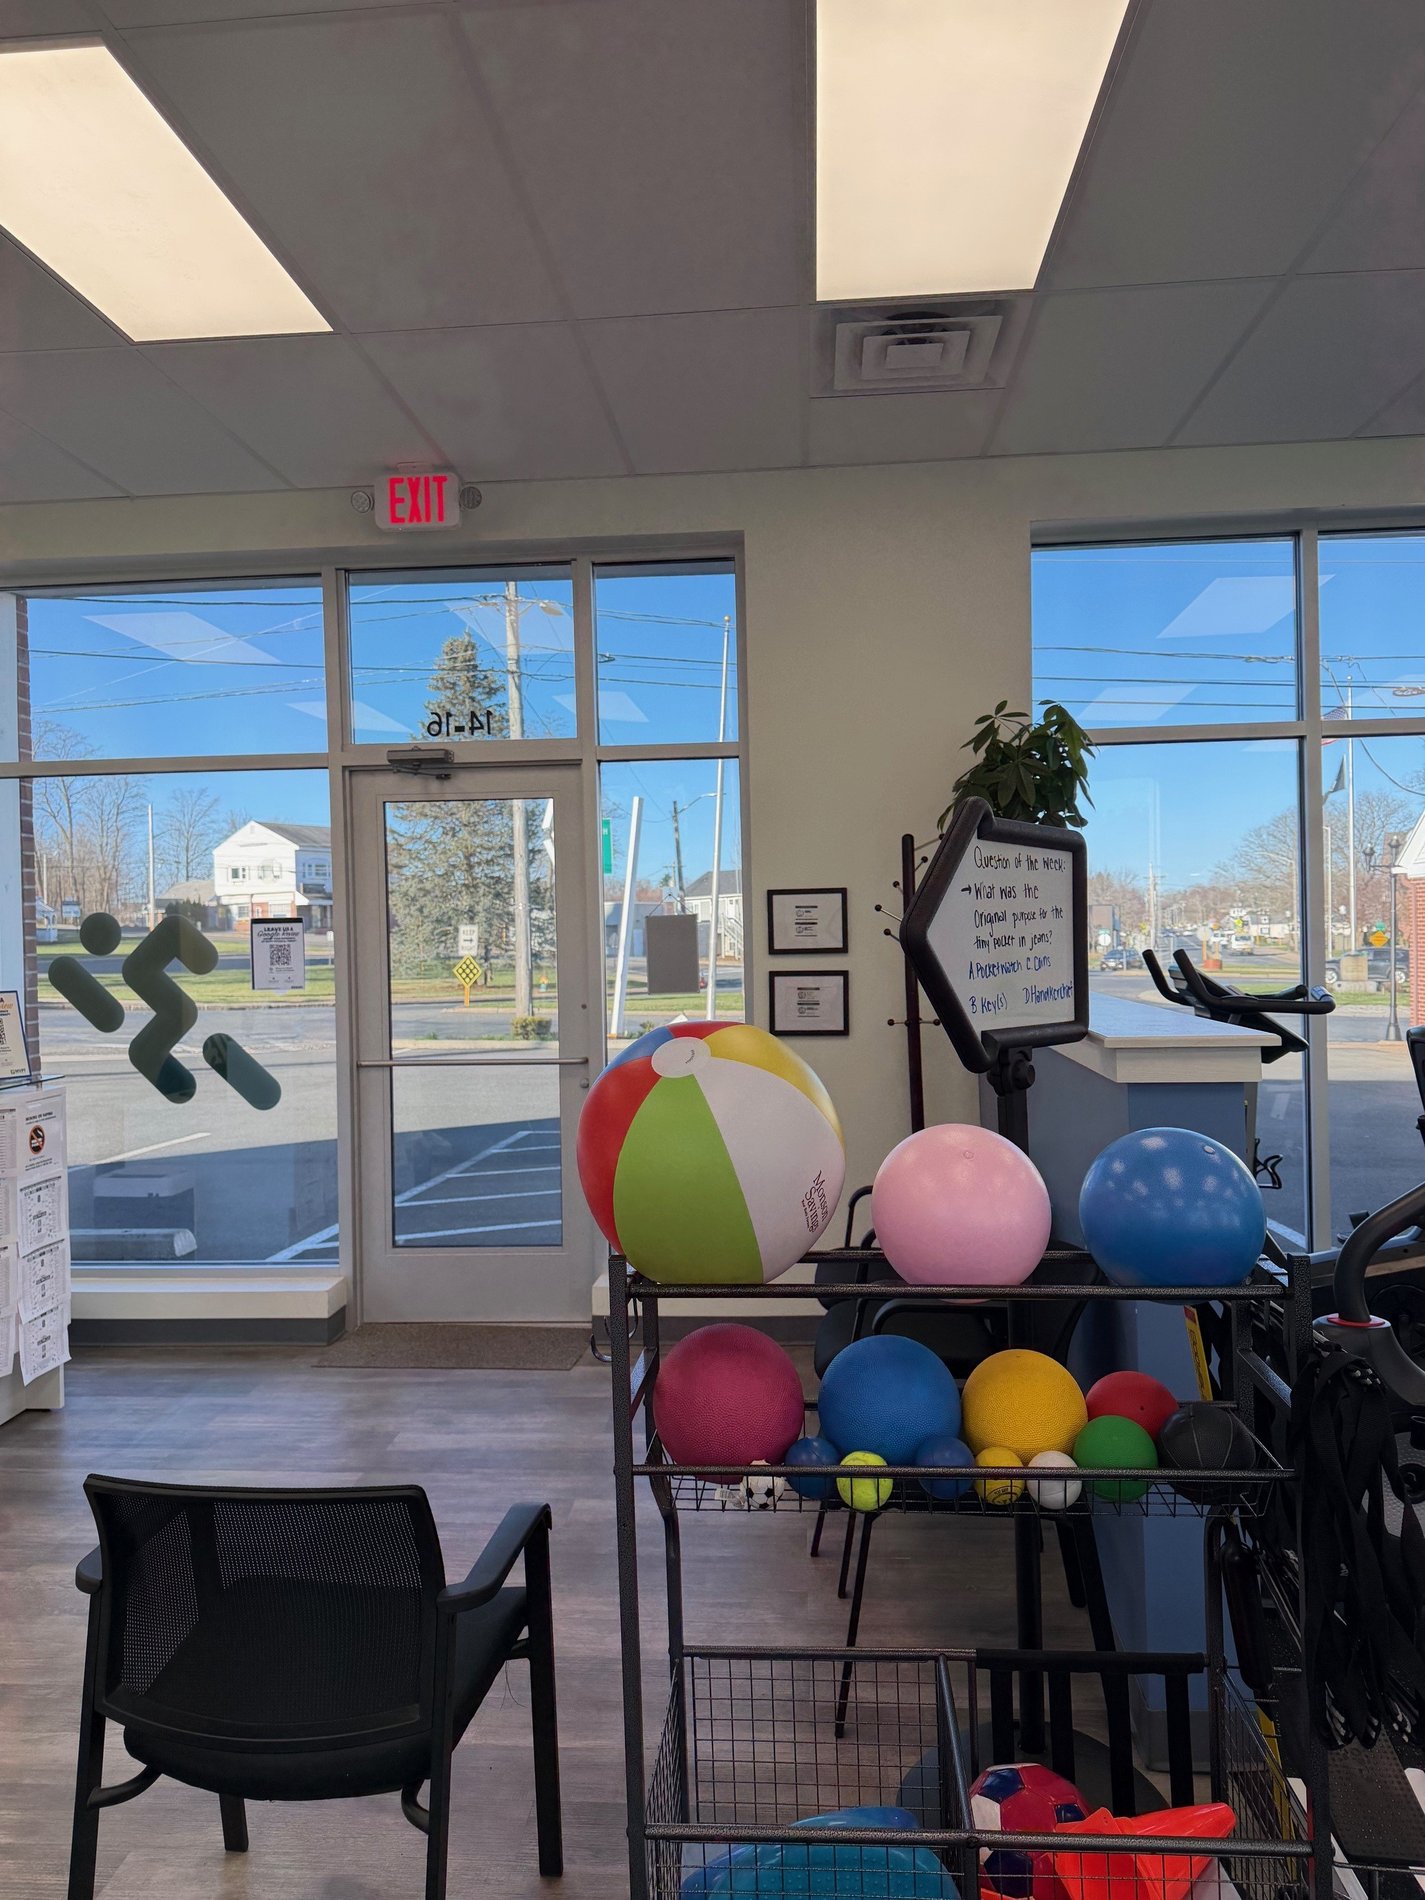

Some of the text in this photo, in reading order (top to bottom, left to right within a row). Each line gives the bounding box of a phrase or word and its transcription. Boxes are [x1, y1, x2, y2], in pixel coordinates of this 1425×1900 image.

[388, 475, 448, 525] EXIT
[974, 846, 1010, 869] Question
[1014, 853, 1022, 869] of
[1026, 854, 1039, 871] the
[974, 881, 995, 900] What
[1023, 883, 1039, 899] the
[974, 905, 1063, 937] Original purpose for the
[973, 930, 1053, 953] tiny pocket in jeans?
[1033, 955, 1051, 971] Coins
[813, 1169, 828, 1222] Monson
